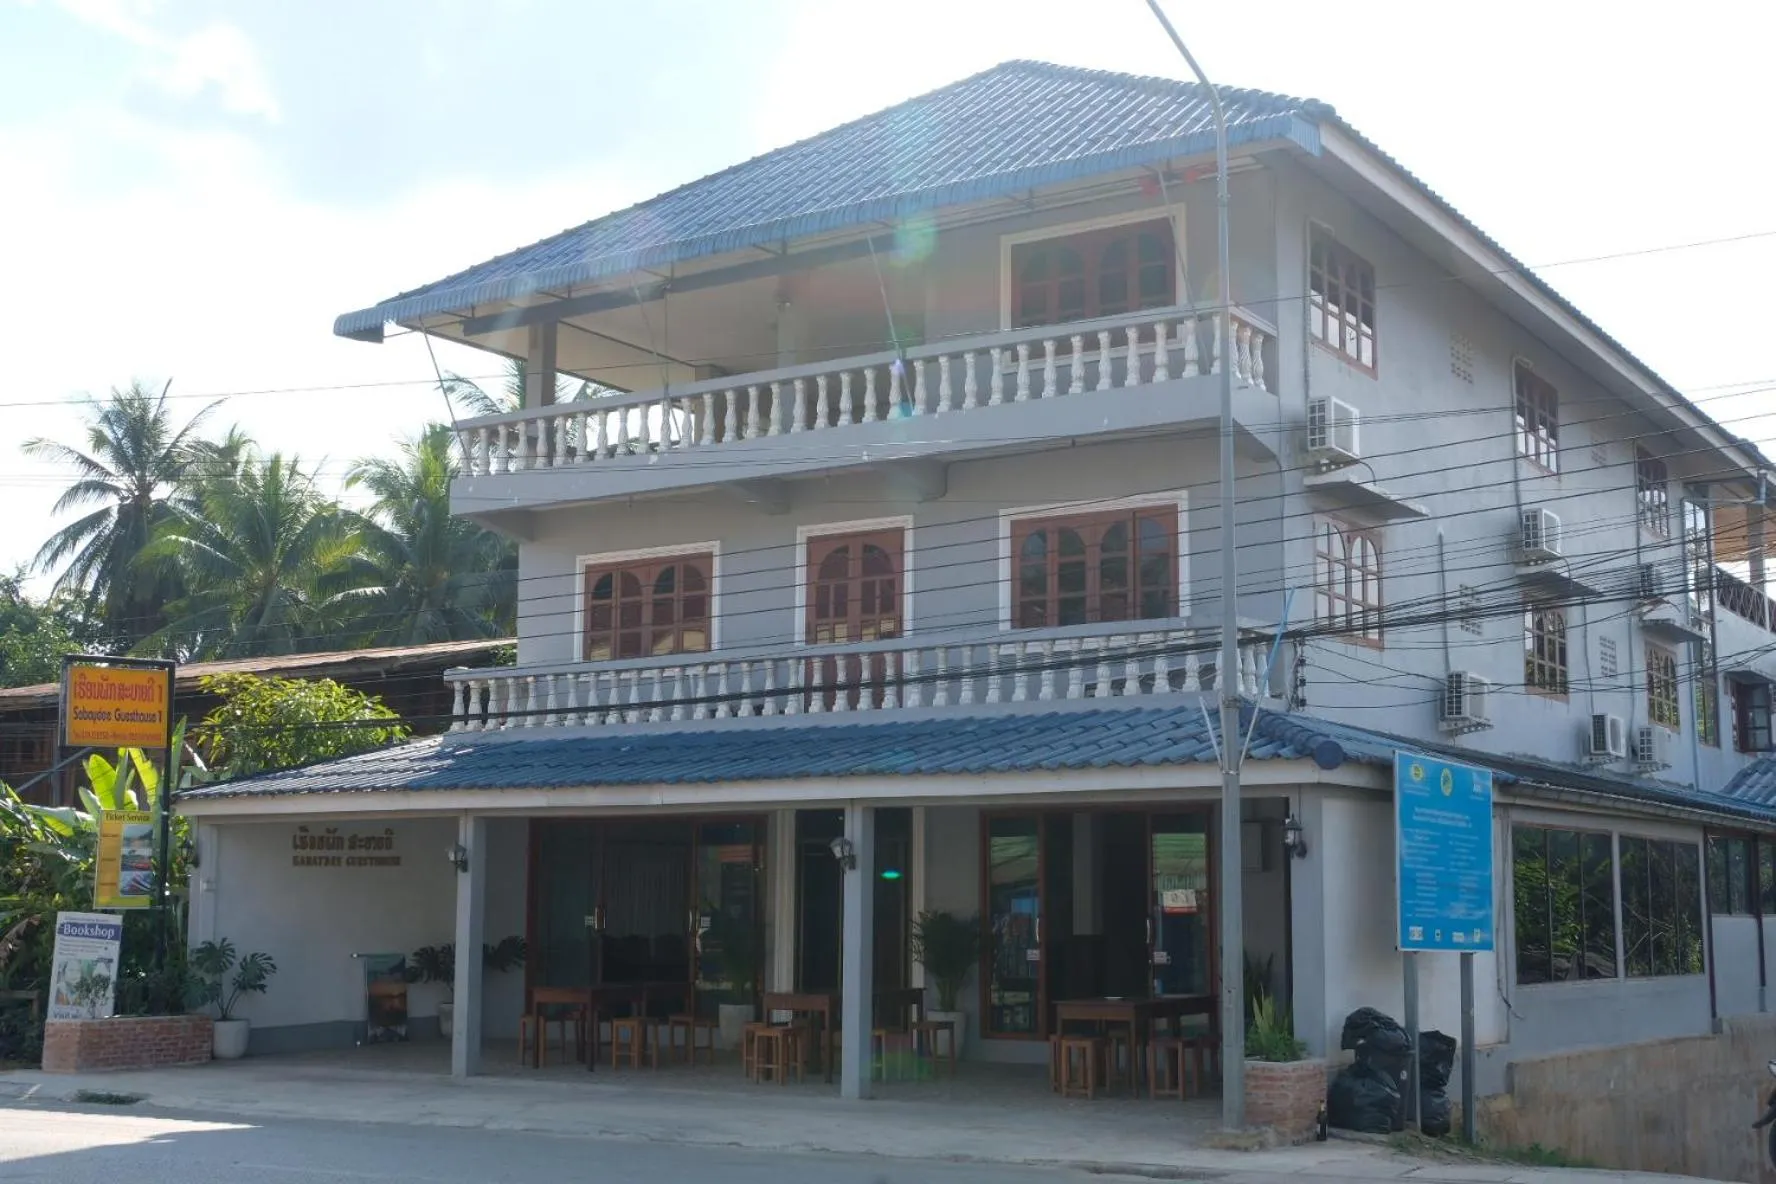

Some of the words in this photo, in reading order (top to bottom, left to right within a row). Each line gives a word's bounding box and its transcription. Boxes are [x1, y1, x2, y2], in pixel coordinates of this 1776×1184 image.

[114, 708, 157, 723] Guesthouse
[105, 813, 125, 821] Ticket
[127, 813, 151, 821] Service
[63, 923, 115, 939] Bookshop
